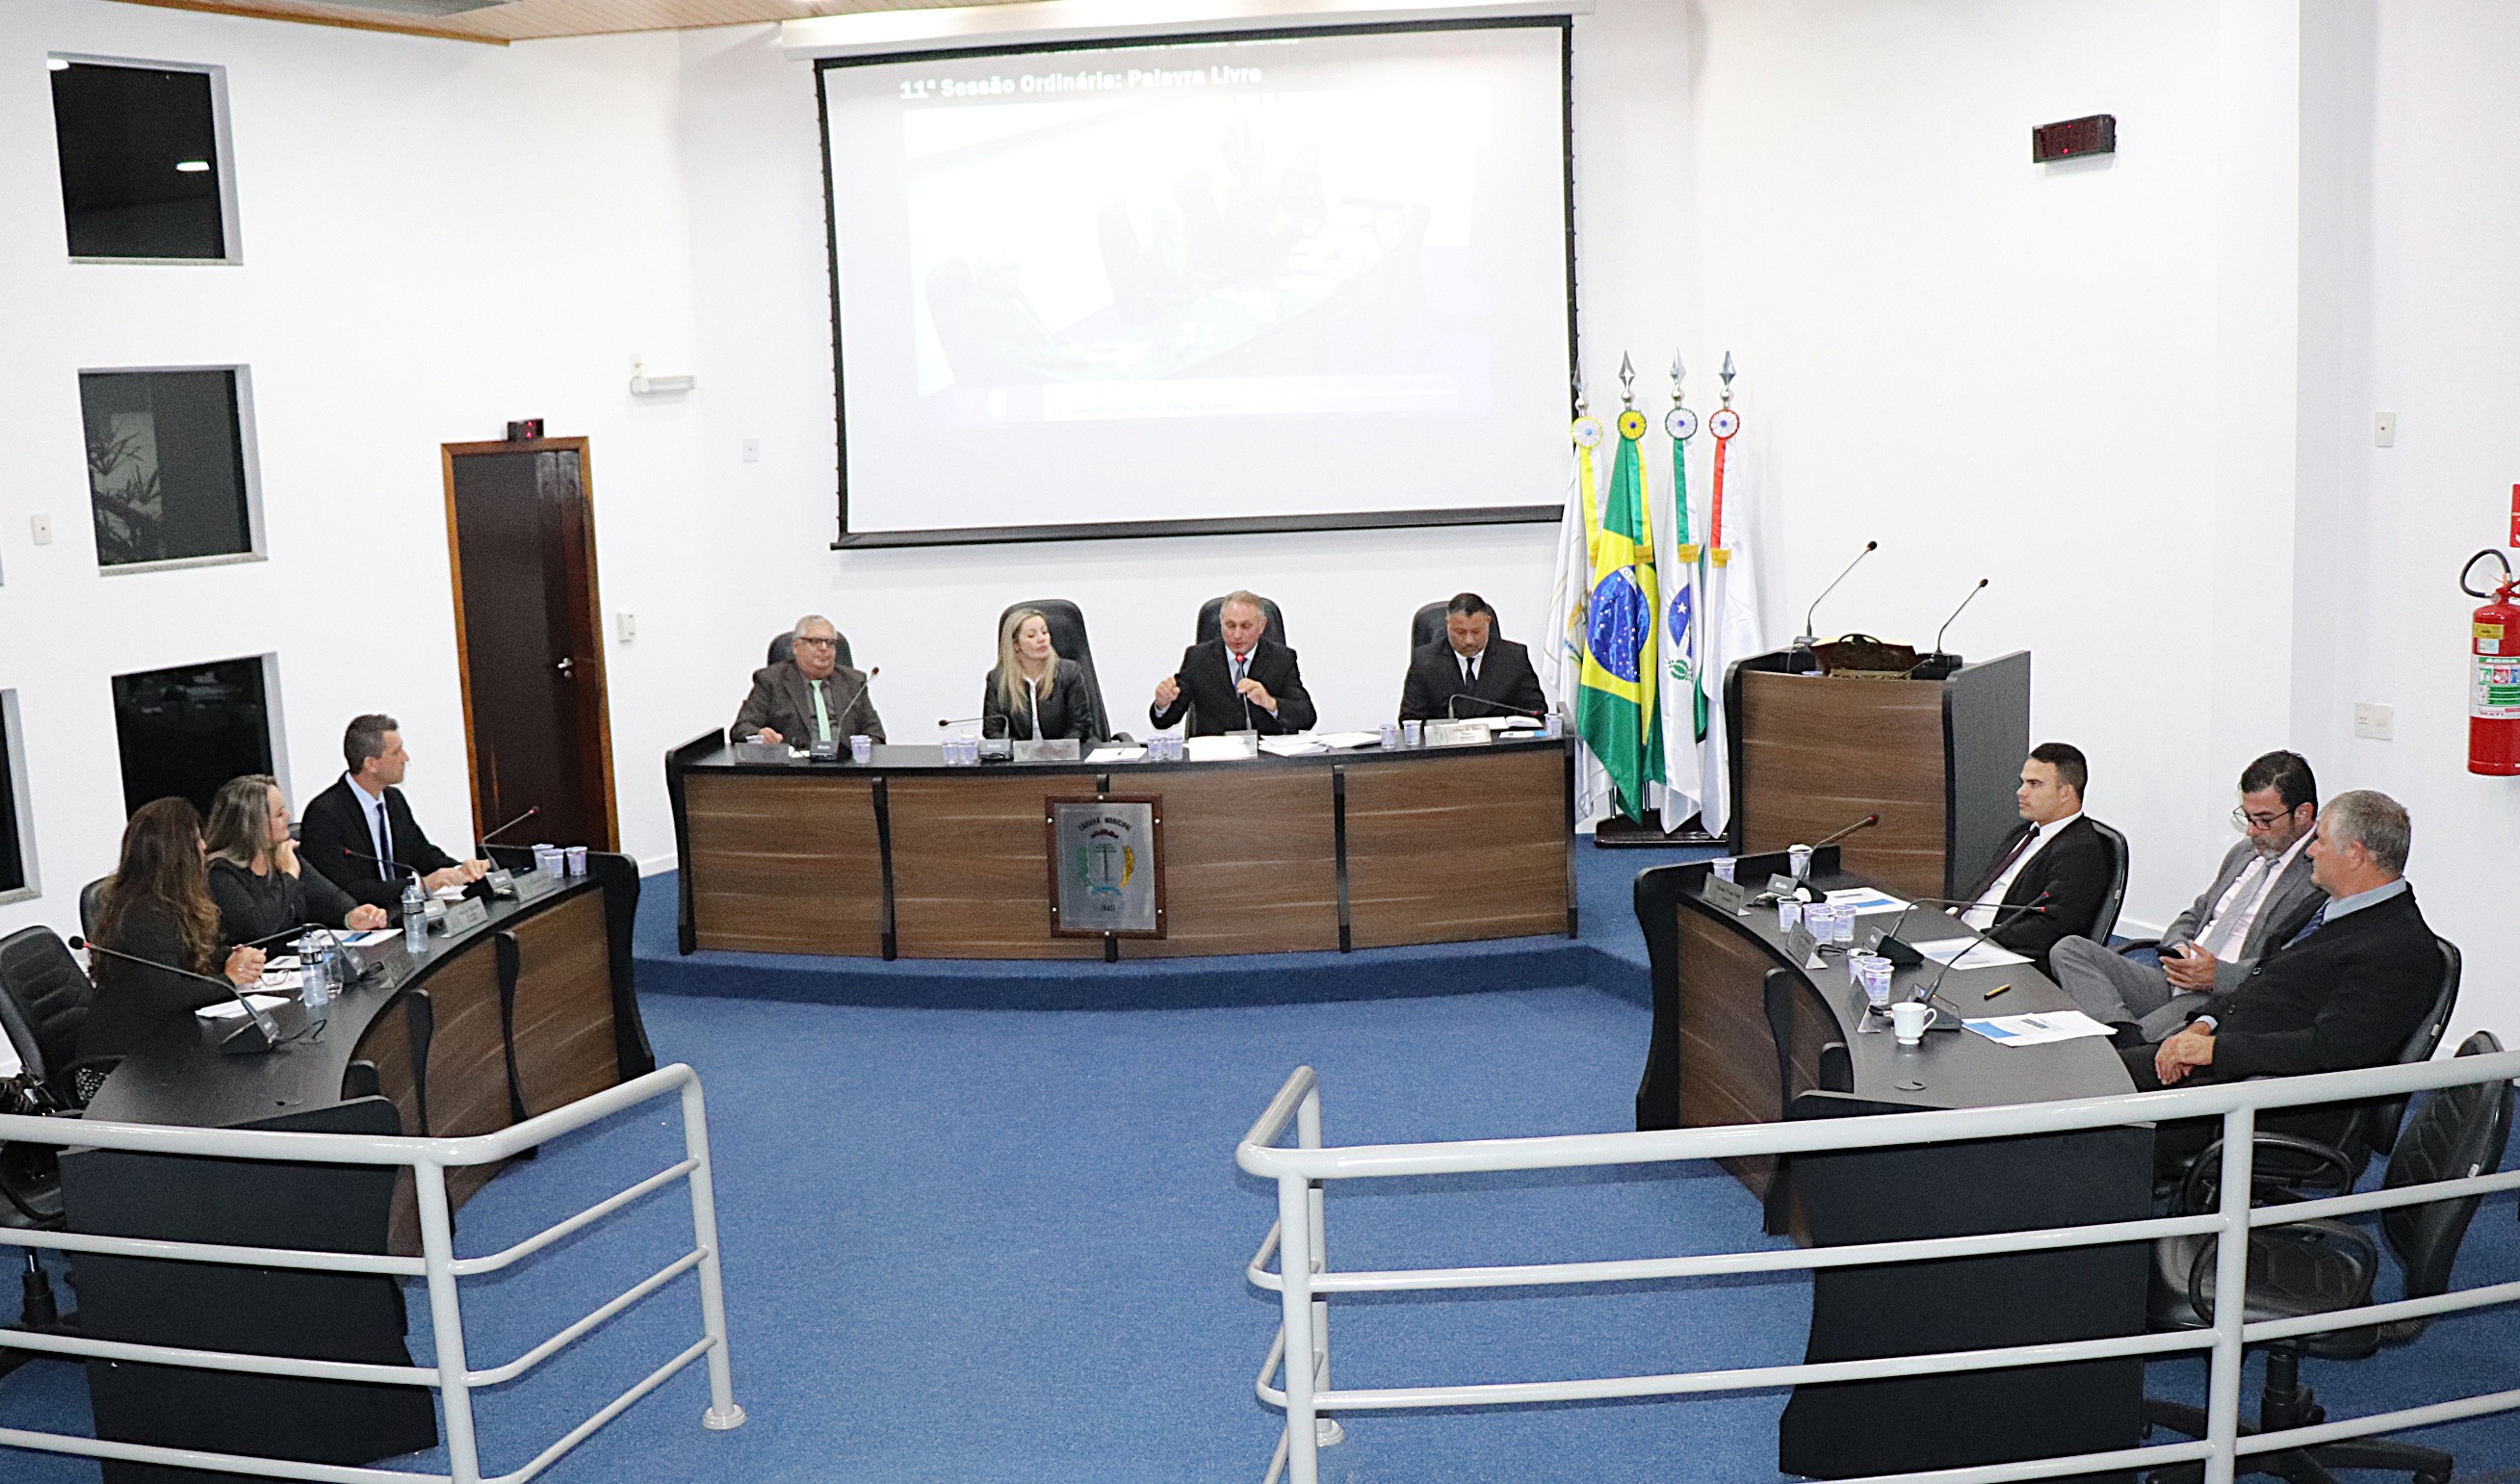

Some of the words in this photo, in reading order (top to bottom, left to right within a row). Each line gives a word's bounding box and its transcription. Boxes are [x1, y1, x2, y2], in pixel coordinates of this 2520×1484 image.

[941, 76, 1015, 97] Sessão
[1020, 71, 1122, 93] Ordinária:
[1128, 67, 1205, 88] Palavra
[1211, 65, 1262, 85] Livre
